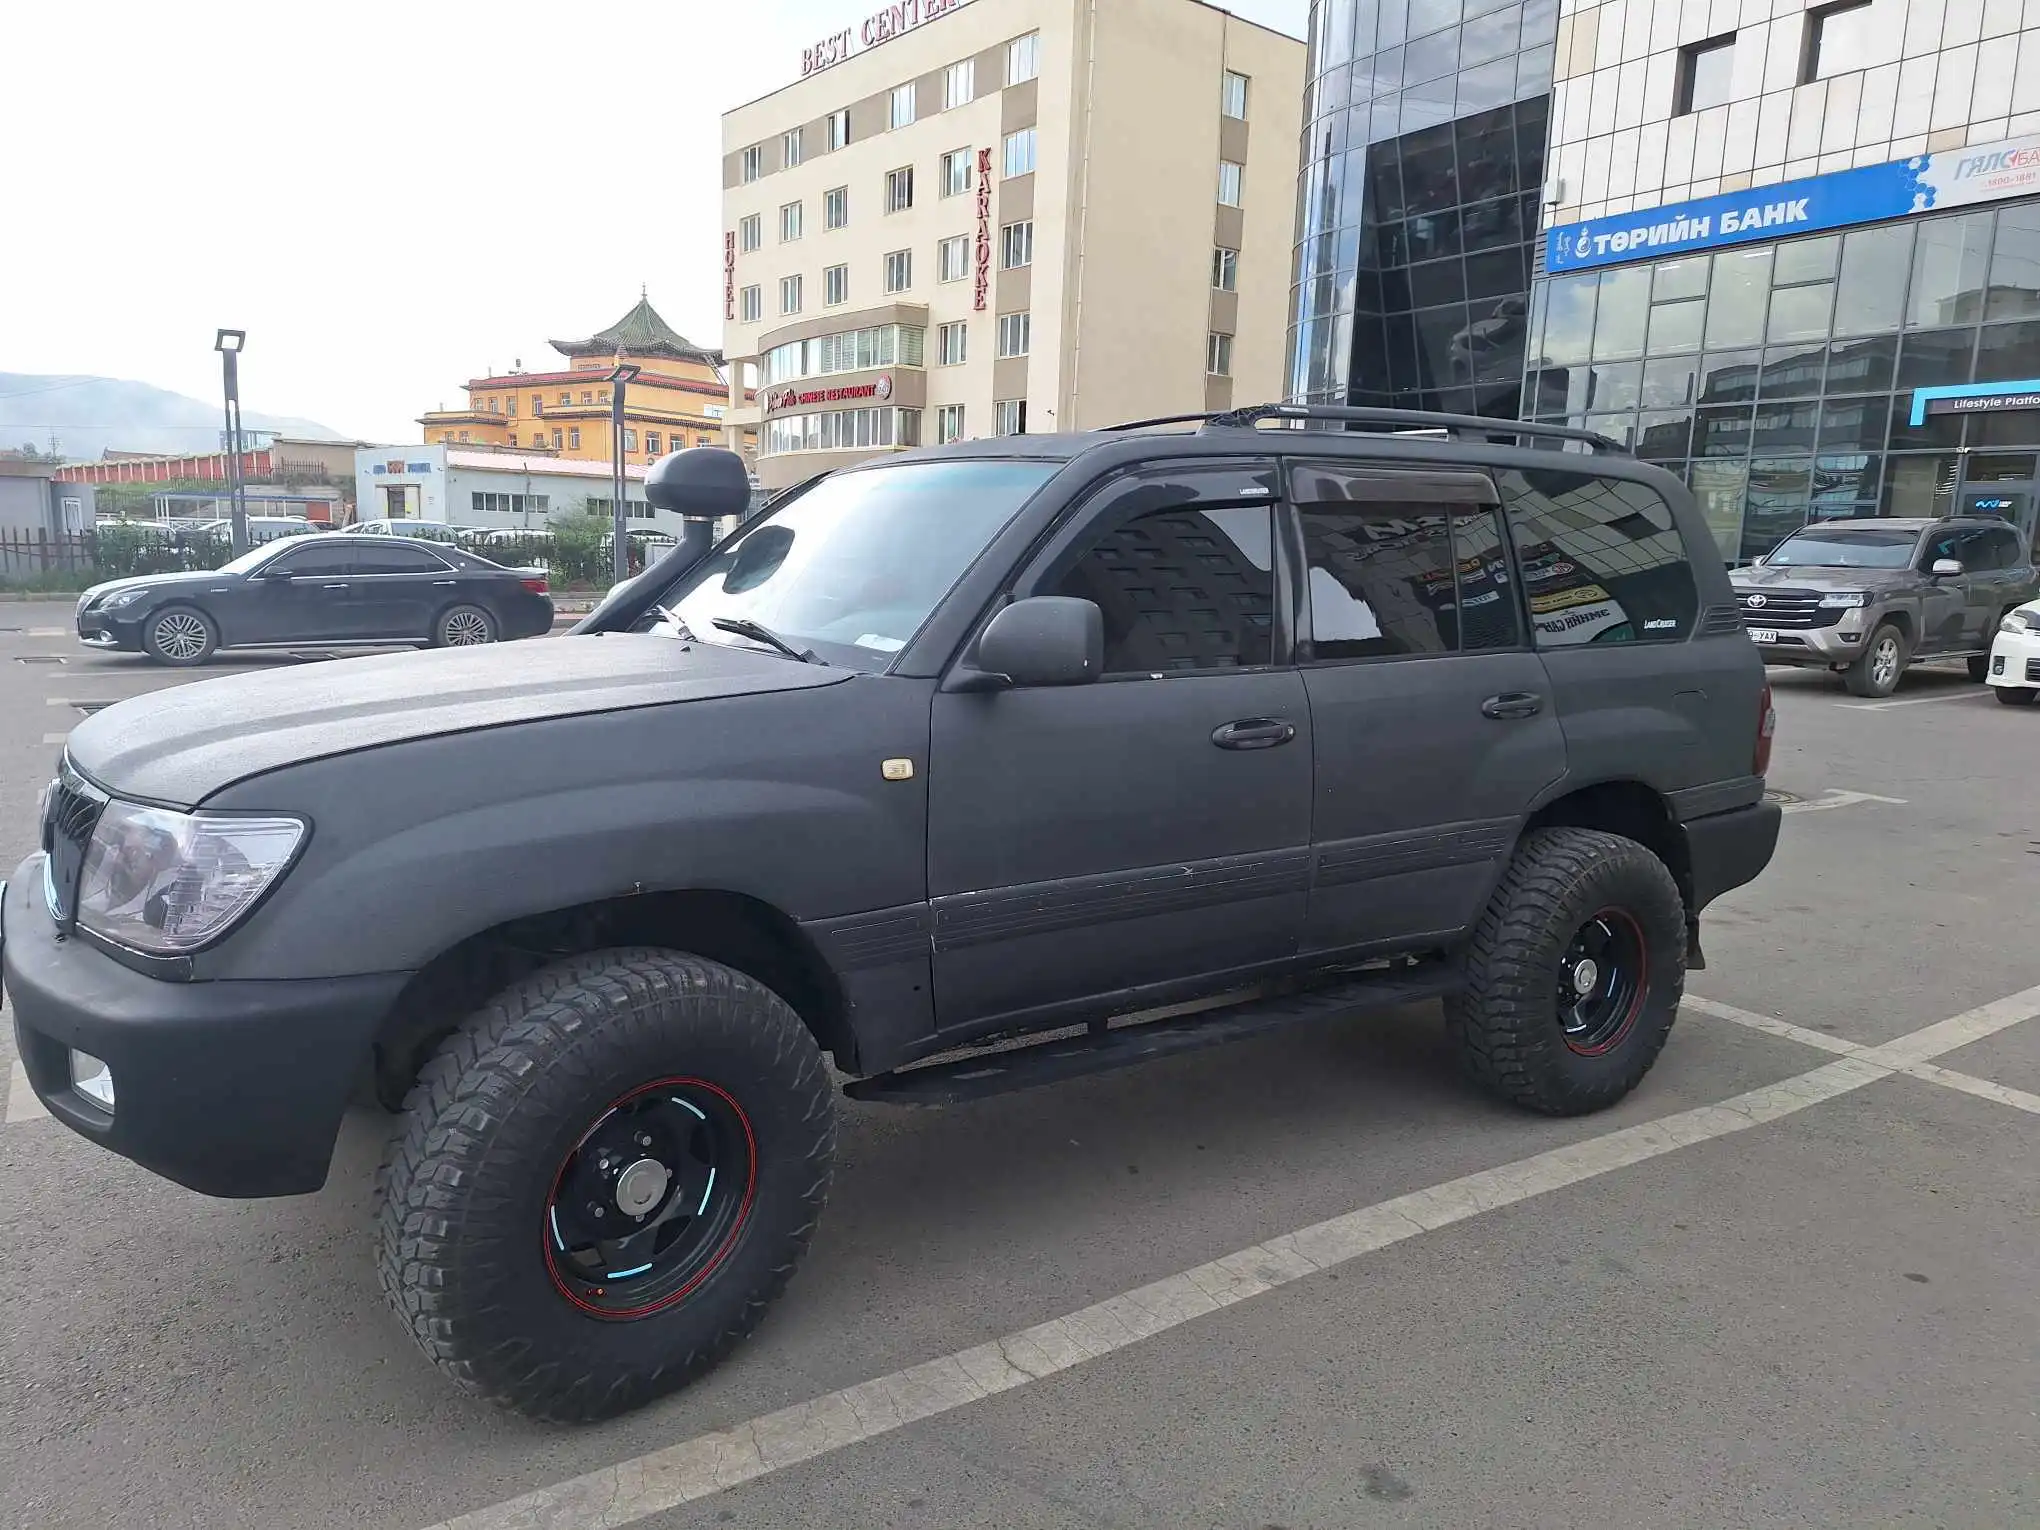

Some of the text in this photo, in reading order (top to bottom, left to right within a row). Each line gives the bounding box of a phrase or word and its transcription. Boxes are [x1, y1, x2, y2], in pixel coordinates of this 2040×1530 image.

[800, 27, 852, 76] BEST
[974, 148, 992, 310] KARAOKE
[1594, 214, 1710, 256] ТӨРИЙН
[1720, 197, 1810, 234] БАНК
[724, 231, 735, 320] HOTEL
[799, 389, 826, 405] CHINESE
[827, 384, 877, 401] RESTAURANT
[1953, 397, 2001, 410] Lifestyle
